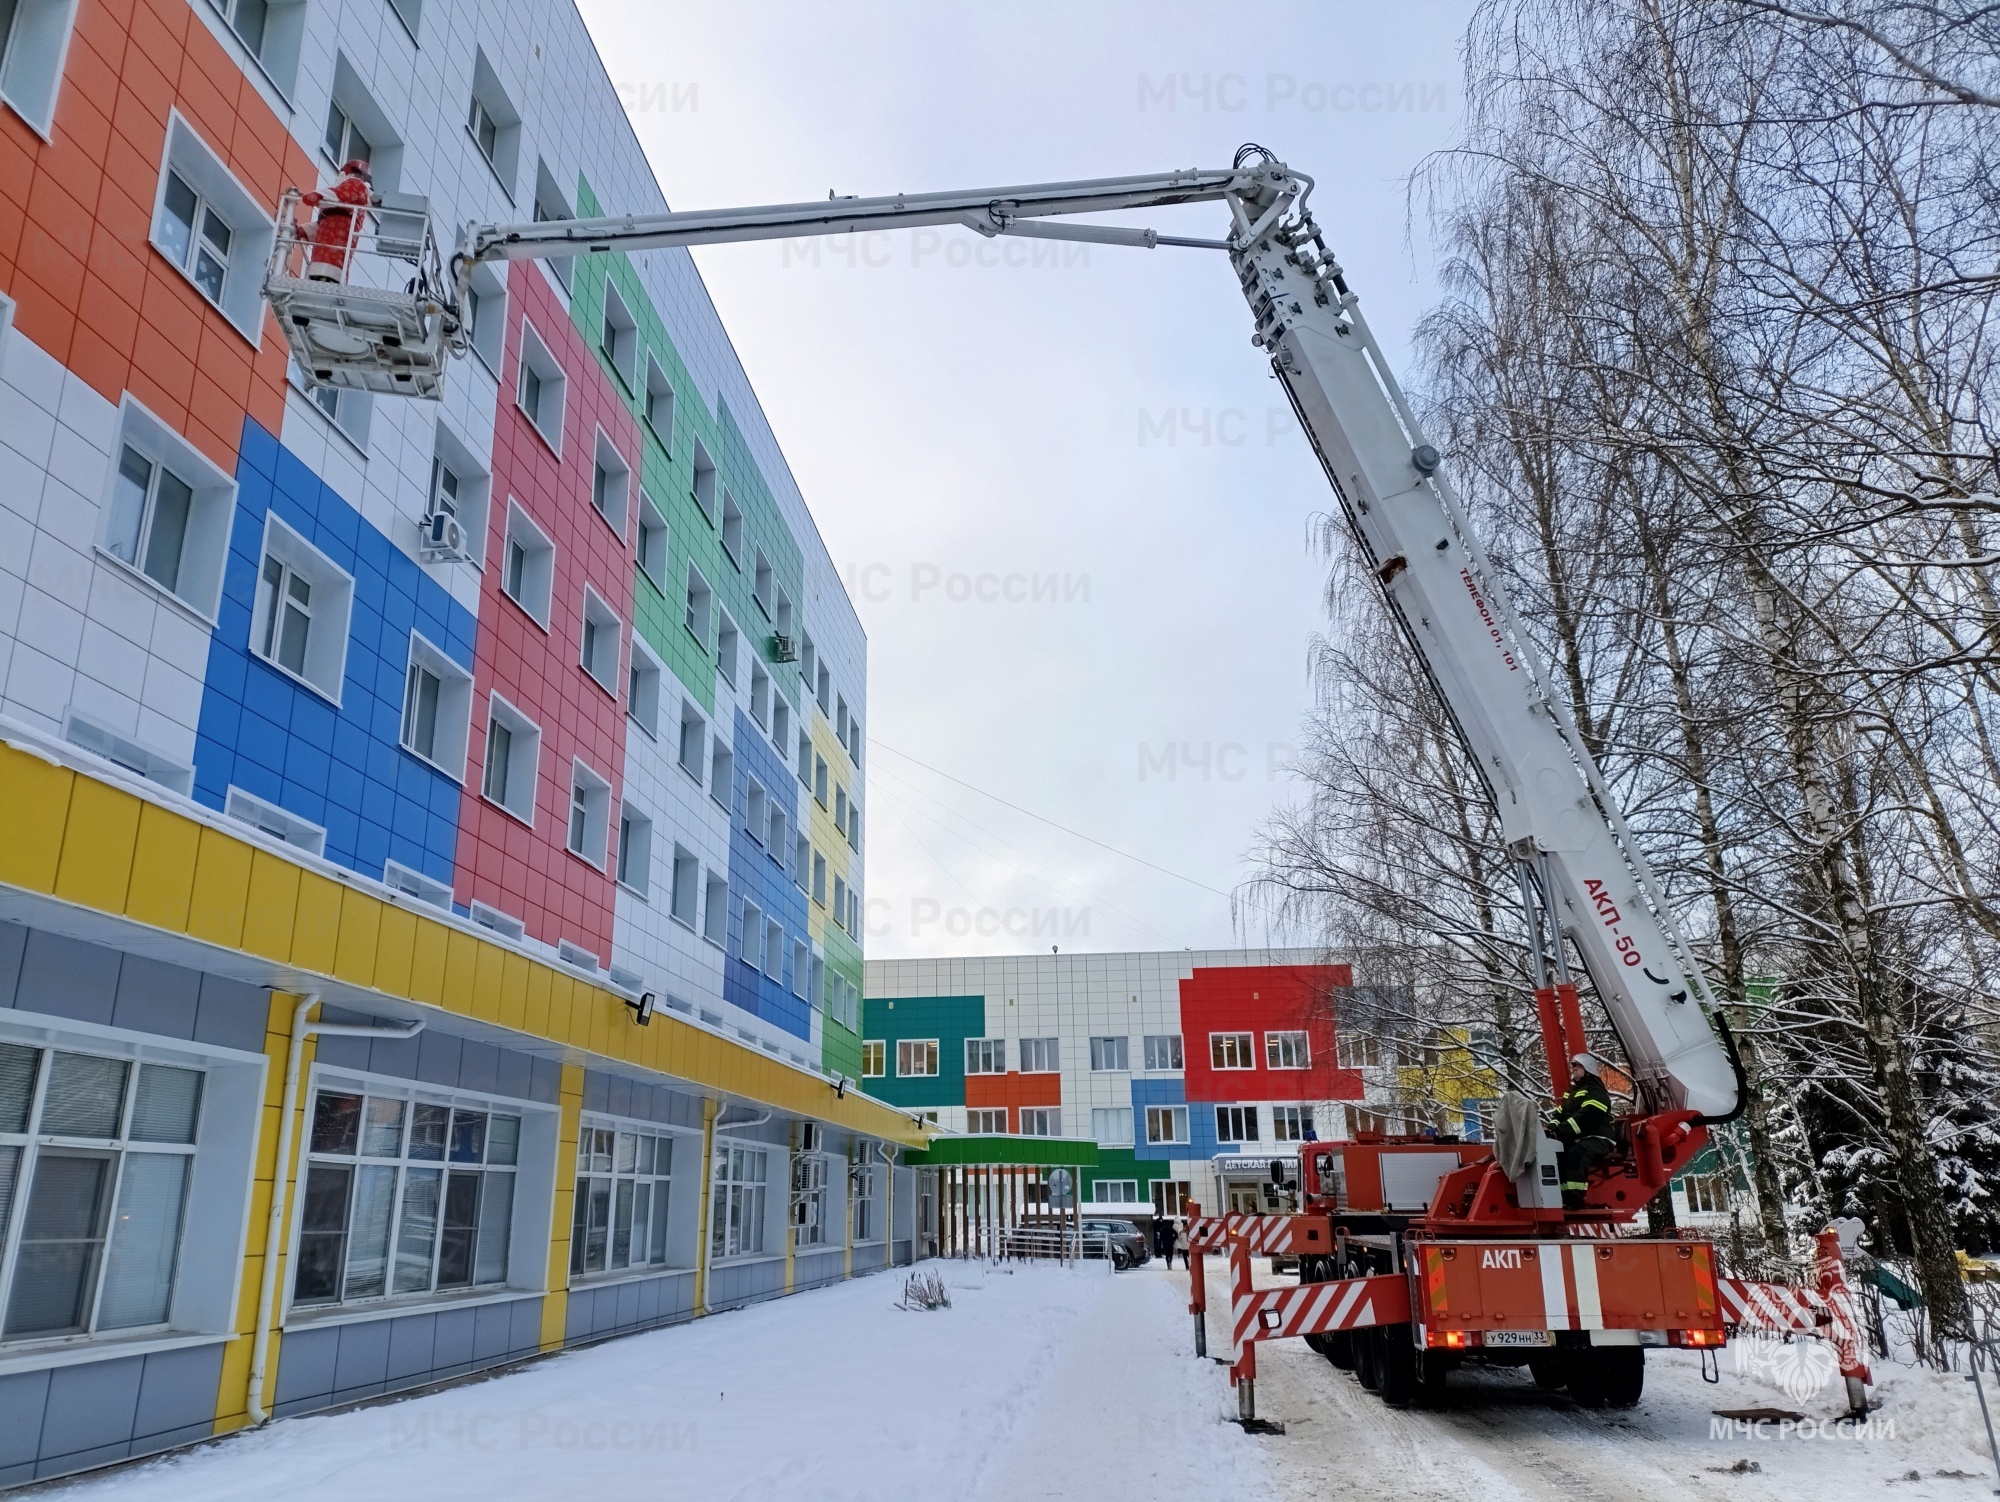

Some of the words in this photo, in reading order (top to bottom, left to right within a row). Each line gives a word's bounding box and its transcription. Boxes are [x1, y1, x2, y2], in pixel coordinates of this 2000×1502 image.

[1459, 567, 1495, 627] ТЕЛЕФОН
[1490, 629, 1504, 649] 01,
[1502, 650, 1519, 672] 101
[1583, 879, 1642, 968] АКП-50
[1224, 1159, 1266, 1170] ДЕТСКАЯ
[1482, 1249, 1522, 1269] АКП
